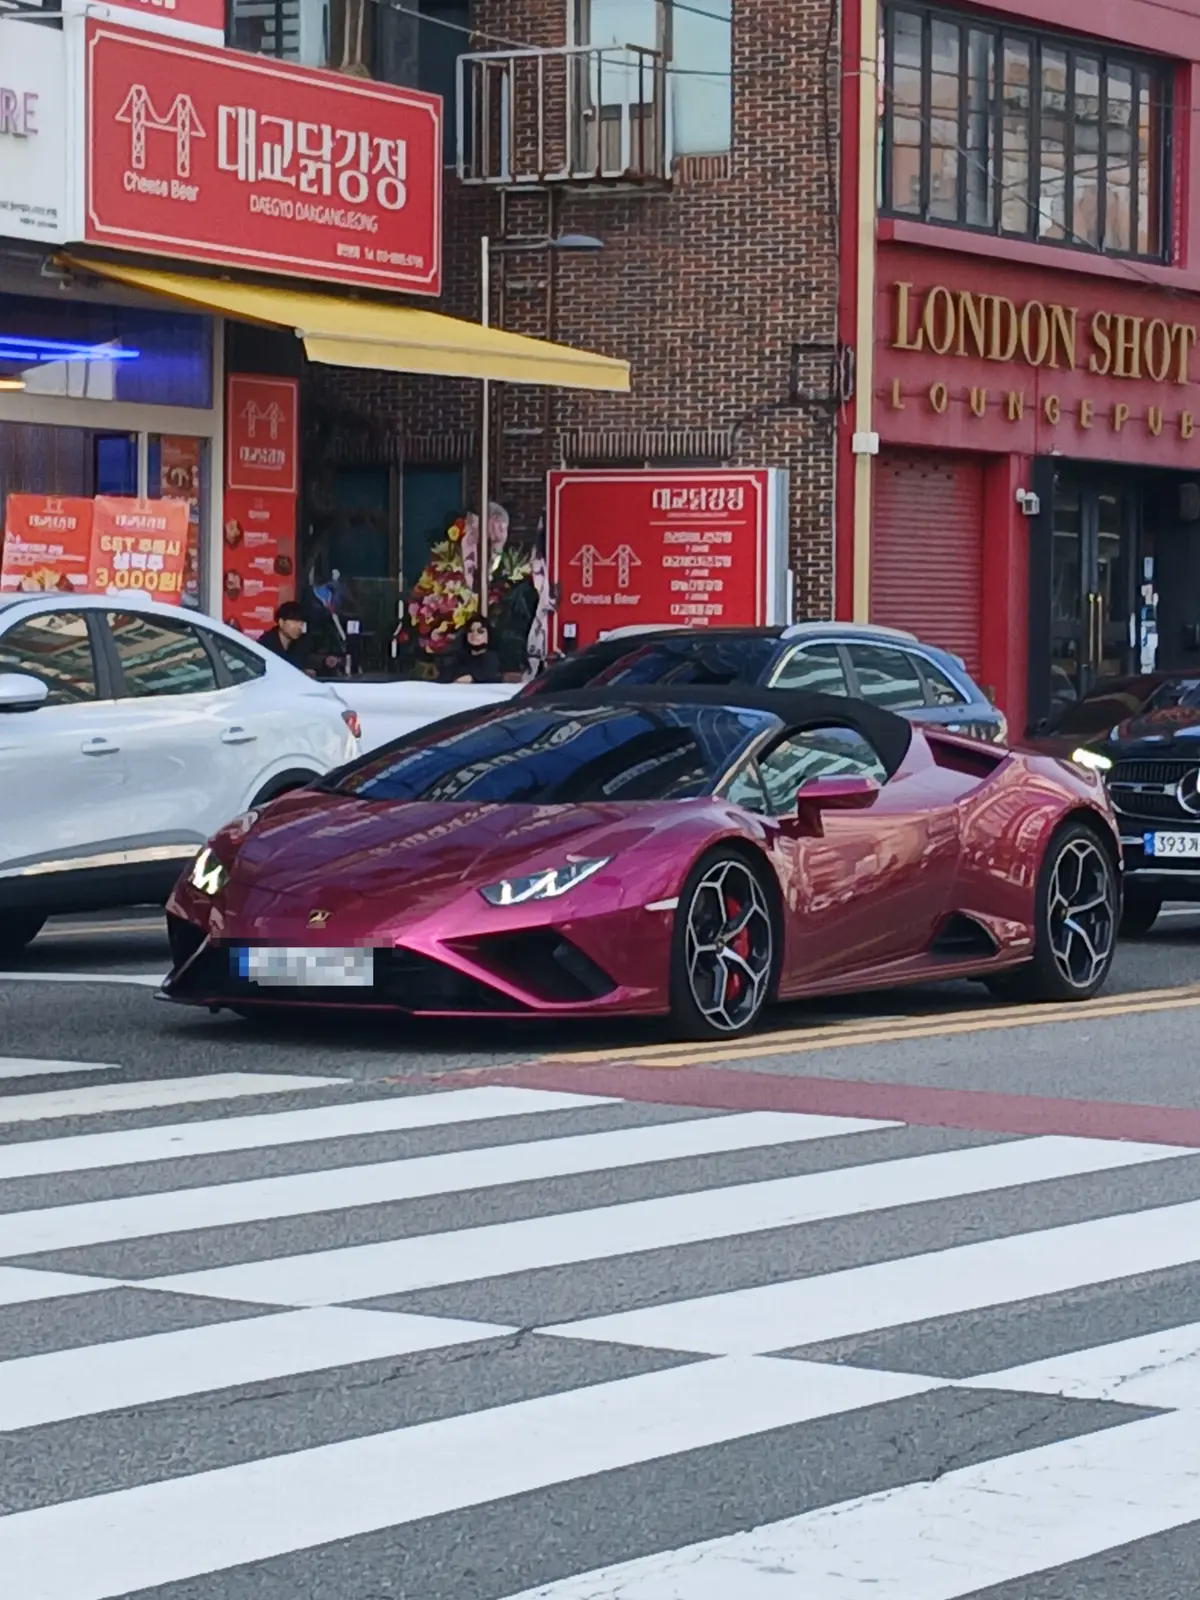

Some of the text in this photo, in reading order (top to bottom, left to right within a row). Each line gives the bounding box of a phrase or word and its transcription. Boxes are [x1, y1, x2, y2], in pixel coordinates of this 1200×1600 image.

[218, 104, 407, 210] 대교닭강정
[123, 170, 199, 201] Cheese Beer
[249, 193, 293, 219] DAEGYO
[892, 281, 1197, 385] LONDON SHOT
[652, 487, 744, 511] 대교닭강정
